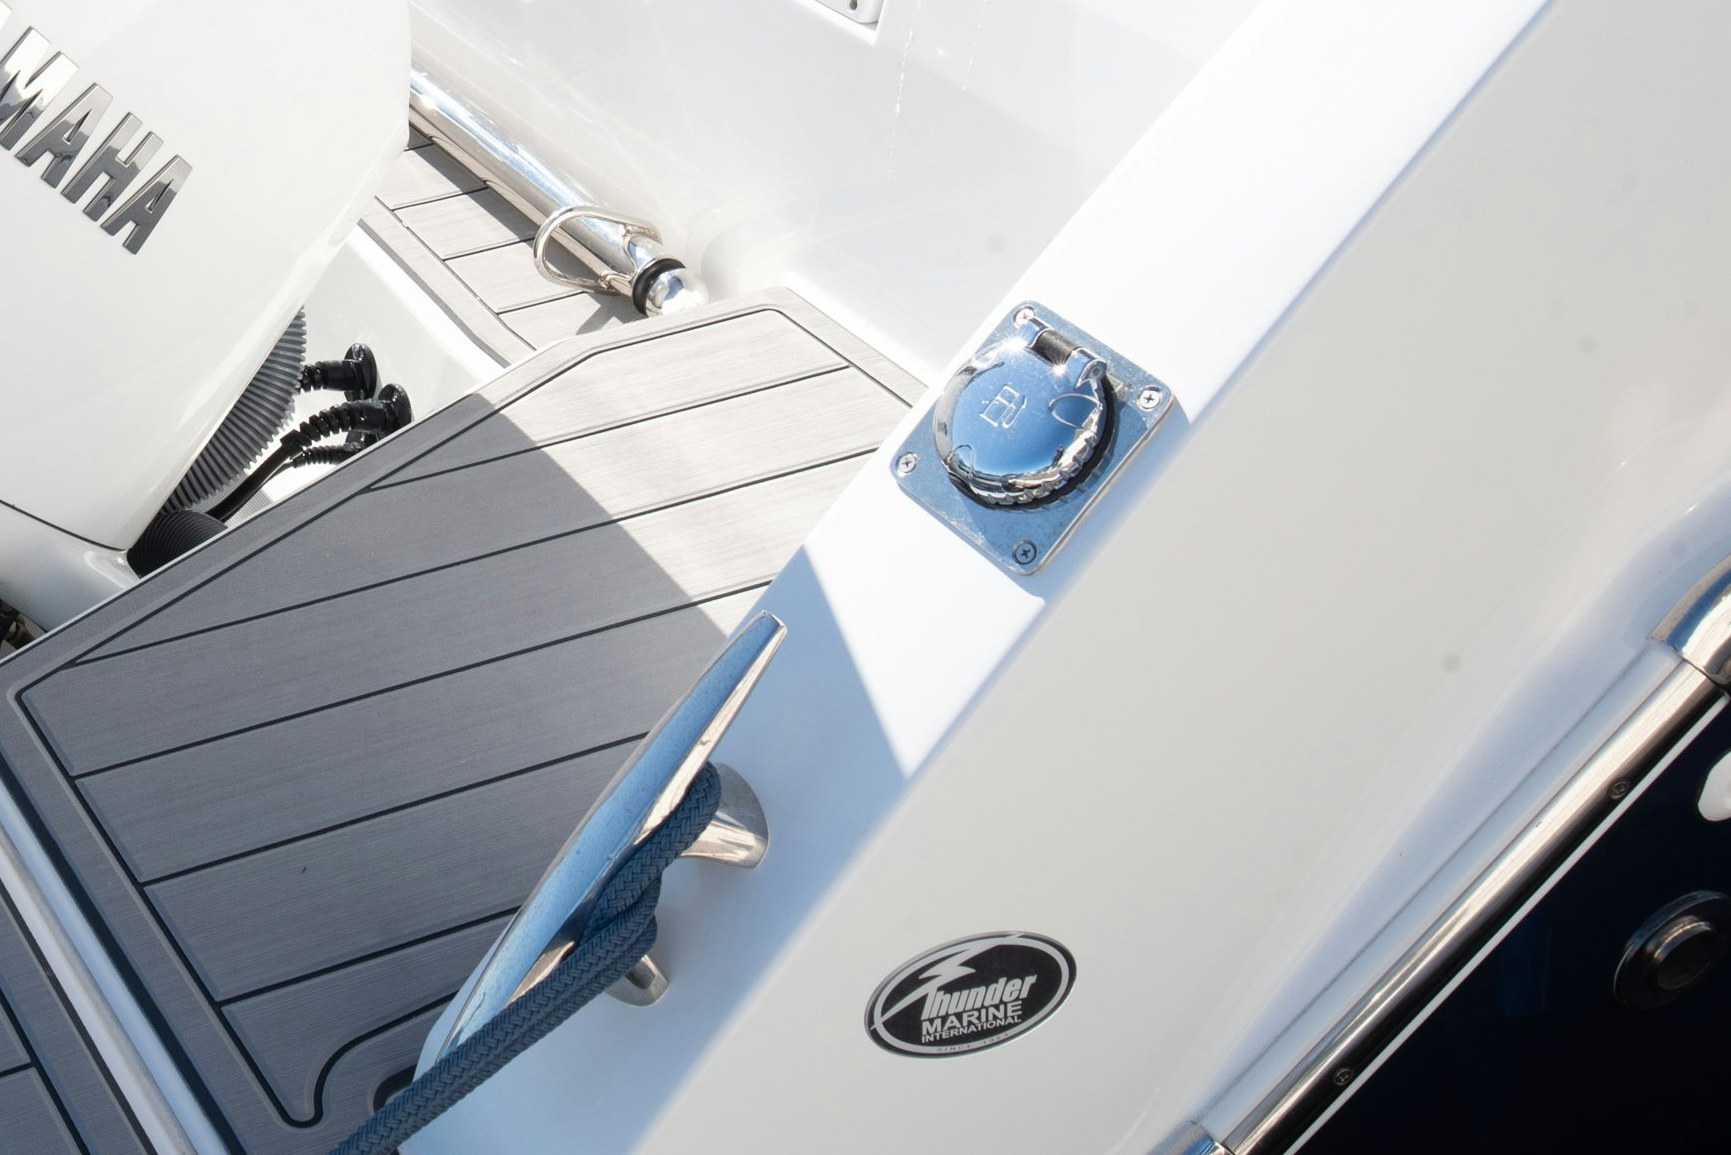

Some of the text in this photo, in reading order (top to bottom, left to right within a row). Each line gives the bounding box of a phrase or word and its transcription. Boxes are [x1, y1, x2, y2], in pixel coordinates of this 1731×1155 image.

[920, 974, 1038, 1021] Thunder
[921, 1000, 1023, 1036] MARINE
[921, 1015, 1023, 1044] INTERNATIONAL
